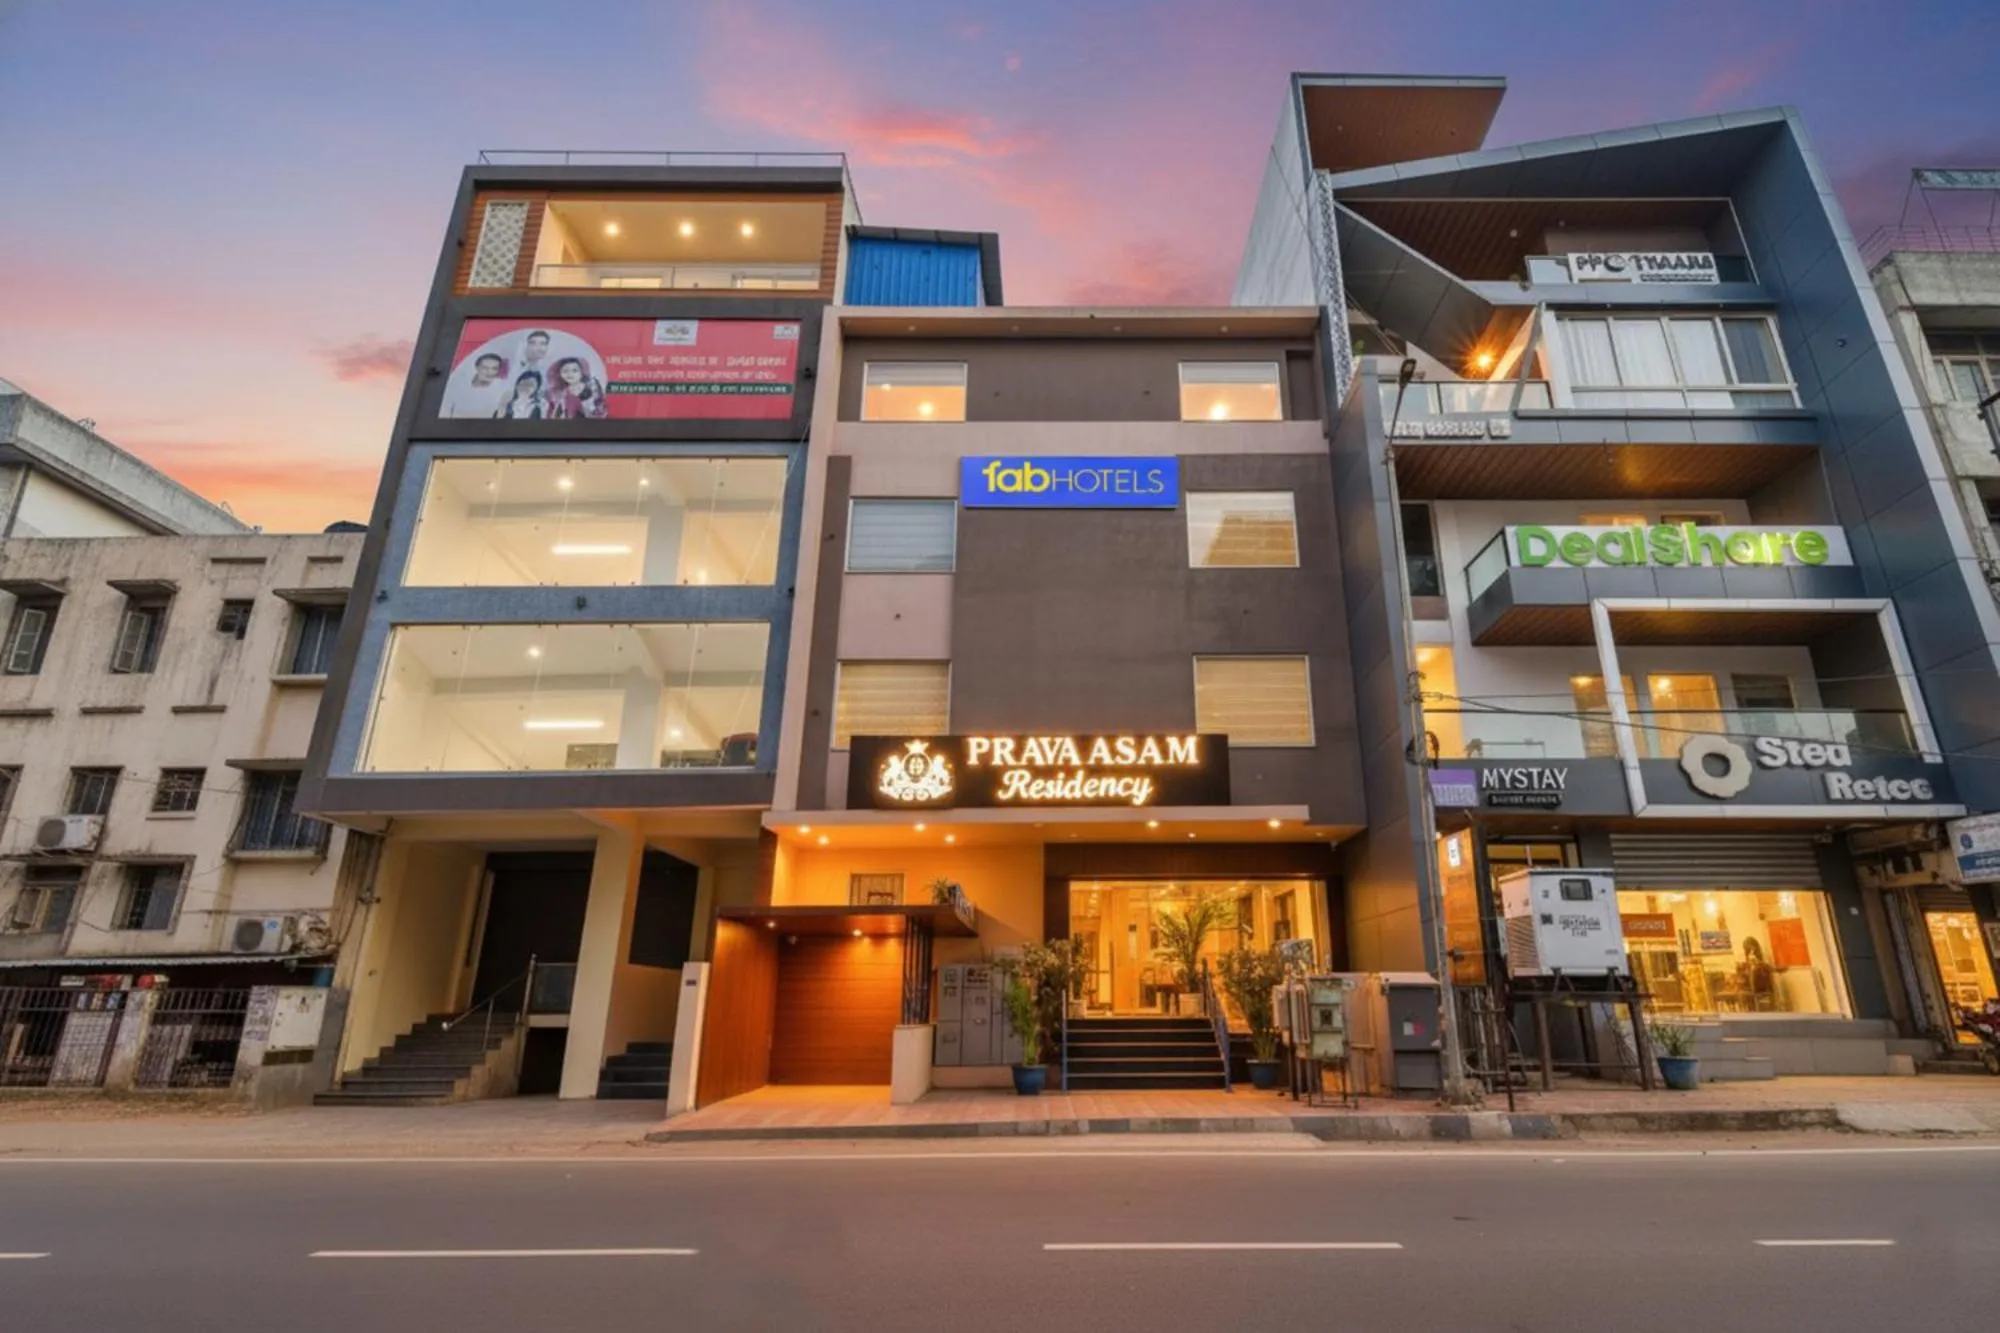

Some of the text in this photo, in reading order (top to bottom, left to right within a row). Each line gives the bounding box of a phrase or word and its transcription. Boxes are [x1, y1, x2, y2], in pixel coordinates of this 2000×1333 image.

[982, 460, 1164, 493] fabHOTELS
[967, 736, 1199, 766] PRAVA ASAM
[997, 769, 1153, 805] Residency
[1482, 767, 1568, 789] MYSTAY
